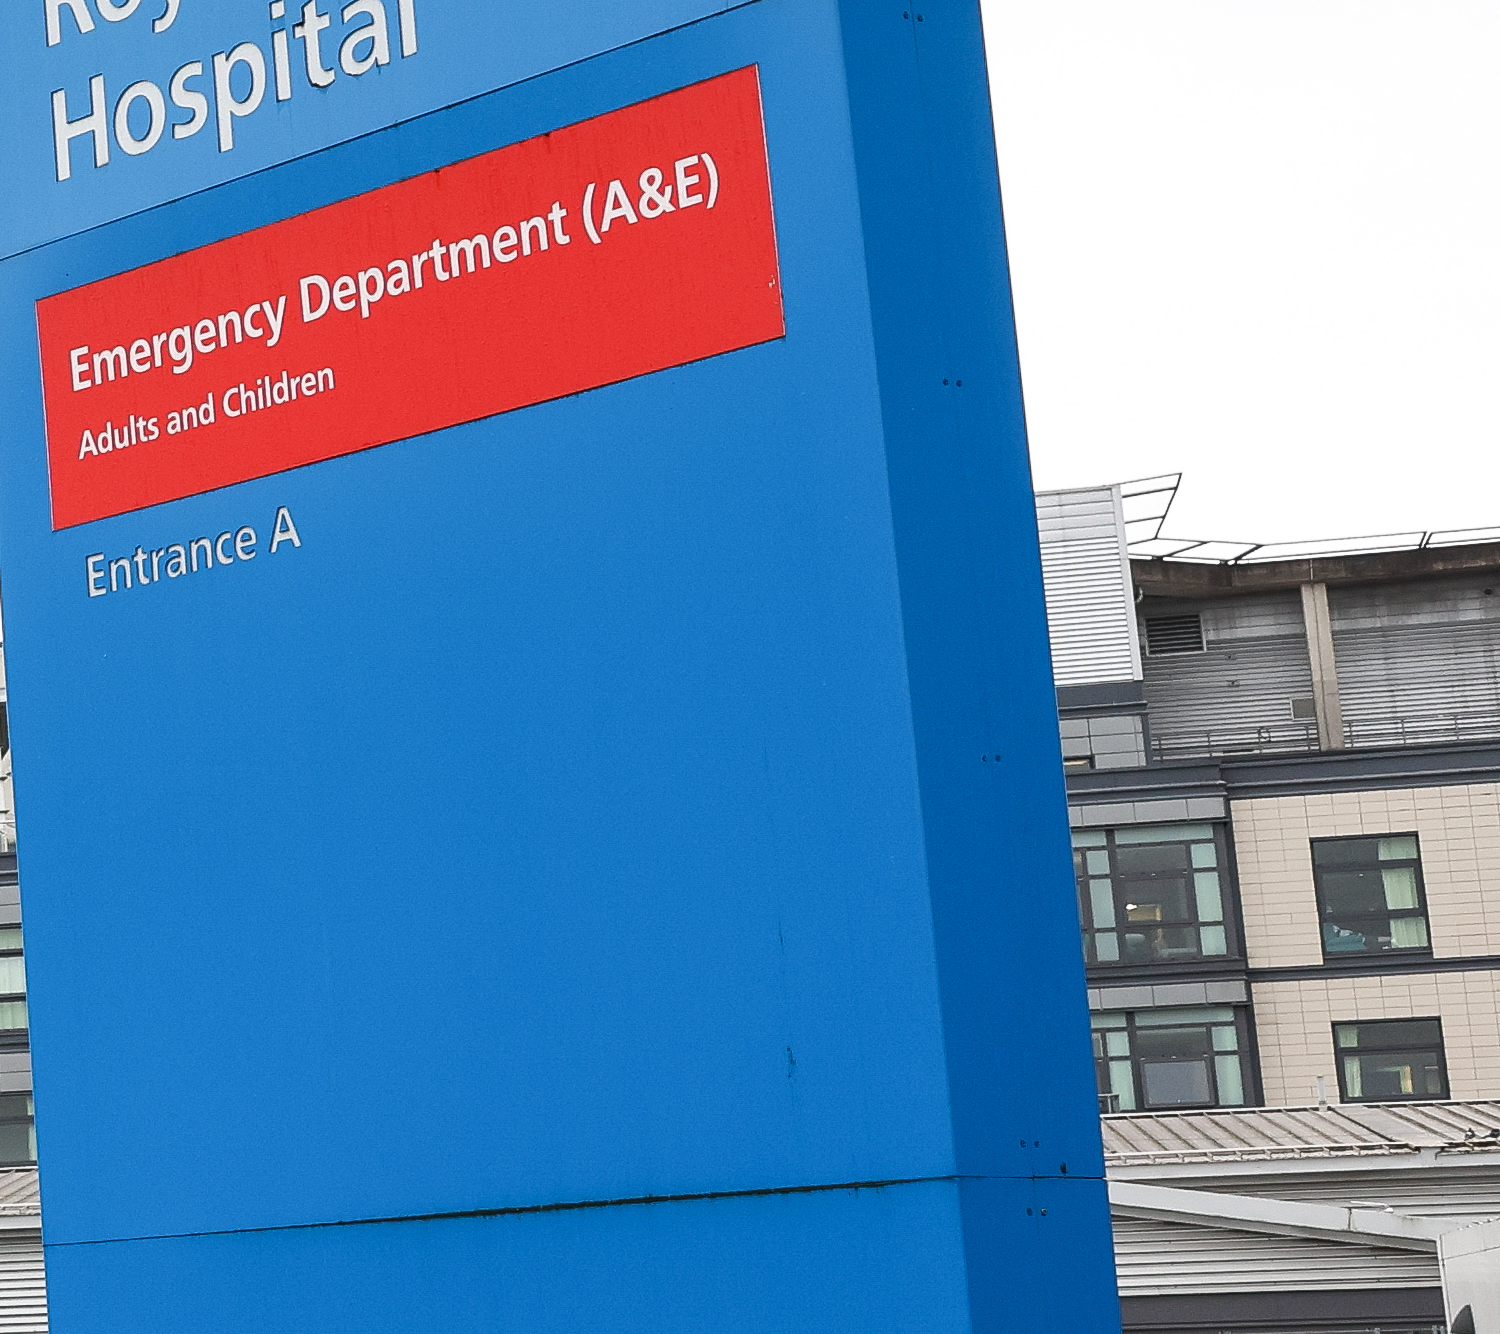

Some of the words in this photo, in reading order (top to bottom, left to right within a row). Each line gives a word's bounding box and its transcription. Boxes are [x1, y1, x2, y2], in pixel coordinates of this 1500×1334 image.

[69, 289, 287, 392] Emergency
[300, 199, 572, 324] Department
[582, 151, 720, 246] (A&E)
[78, 415, 160, 460] Adults
[166, 392, 217, 435] and
[222, 362, 335, 421] Children
[85, 524, 257, 599] Entrance
[268, 505, 301, 552] A
